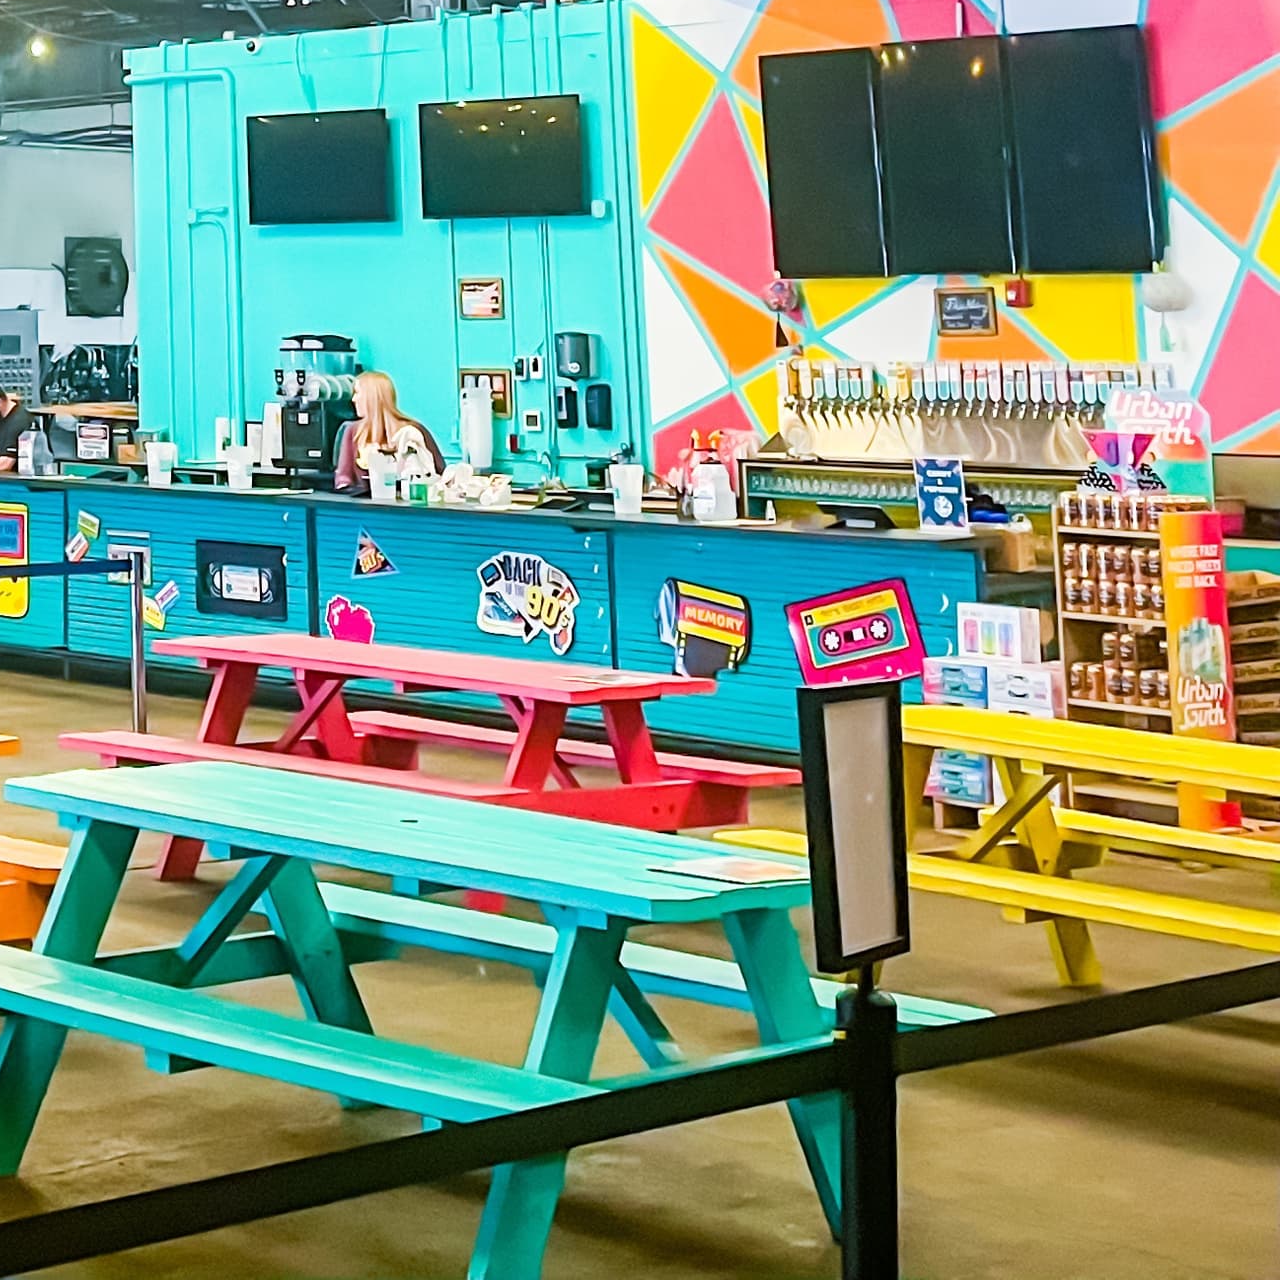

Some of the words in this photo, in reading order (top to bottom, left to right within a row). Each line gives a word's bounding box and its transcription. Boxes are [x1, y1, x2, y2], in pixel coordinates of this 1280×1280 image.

[1112, 390, 1192, 420] Urban
[1194, 574, 1218, 588] BACK
[683, 605, 744, 632] MEMORY
[1178, 675, 1224, 704] Urban
[1179, 701, 1226, 730] South
